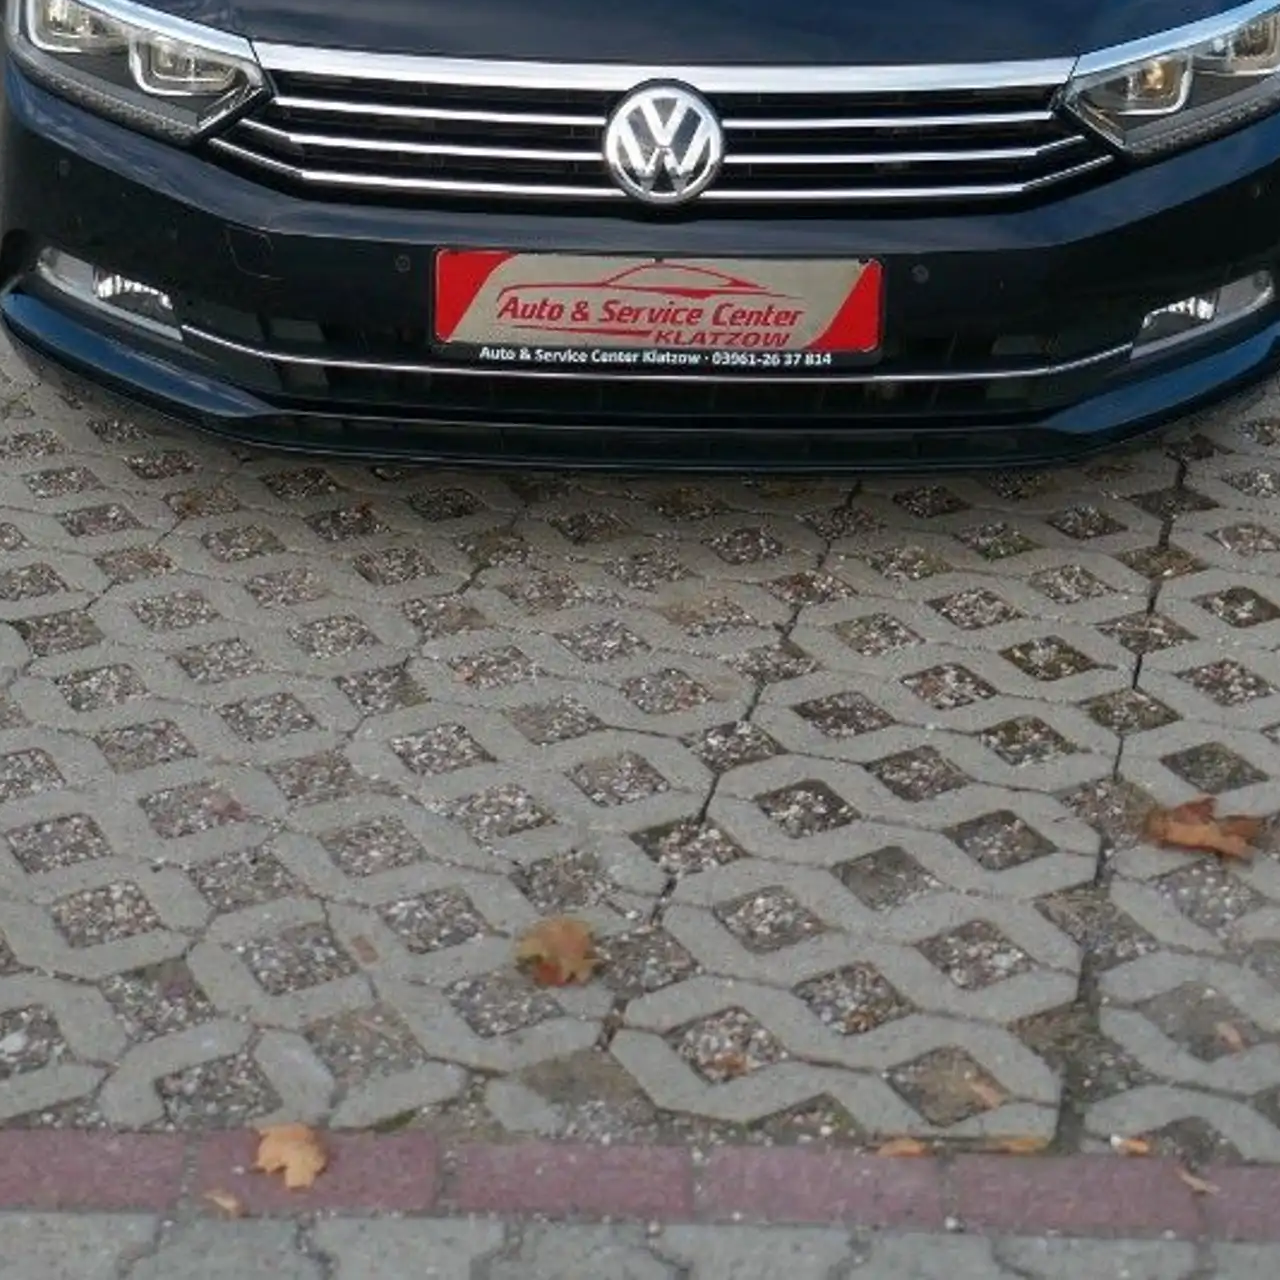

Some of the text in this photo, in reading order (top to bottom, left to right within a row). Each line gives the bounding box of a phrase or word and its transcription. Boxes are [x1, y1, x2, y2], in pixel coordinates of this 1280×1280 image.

[606, 86, 721, 204] VW
[497, 297, 803, 327] Auto & Service Center
[653, 329, 791, 347] KLATZOW
[479, 346, 516, 361] Auto
[520, 348, 531, 361] &
[534, 348, 588, 363] Service
[591, 349, 639, 363] Center
[642, 349, 701, 364] Klatzow
